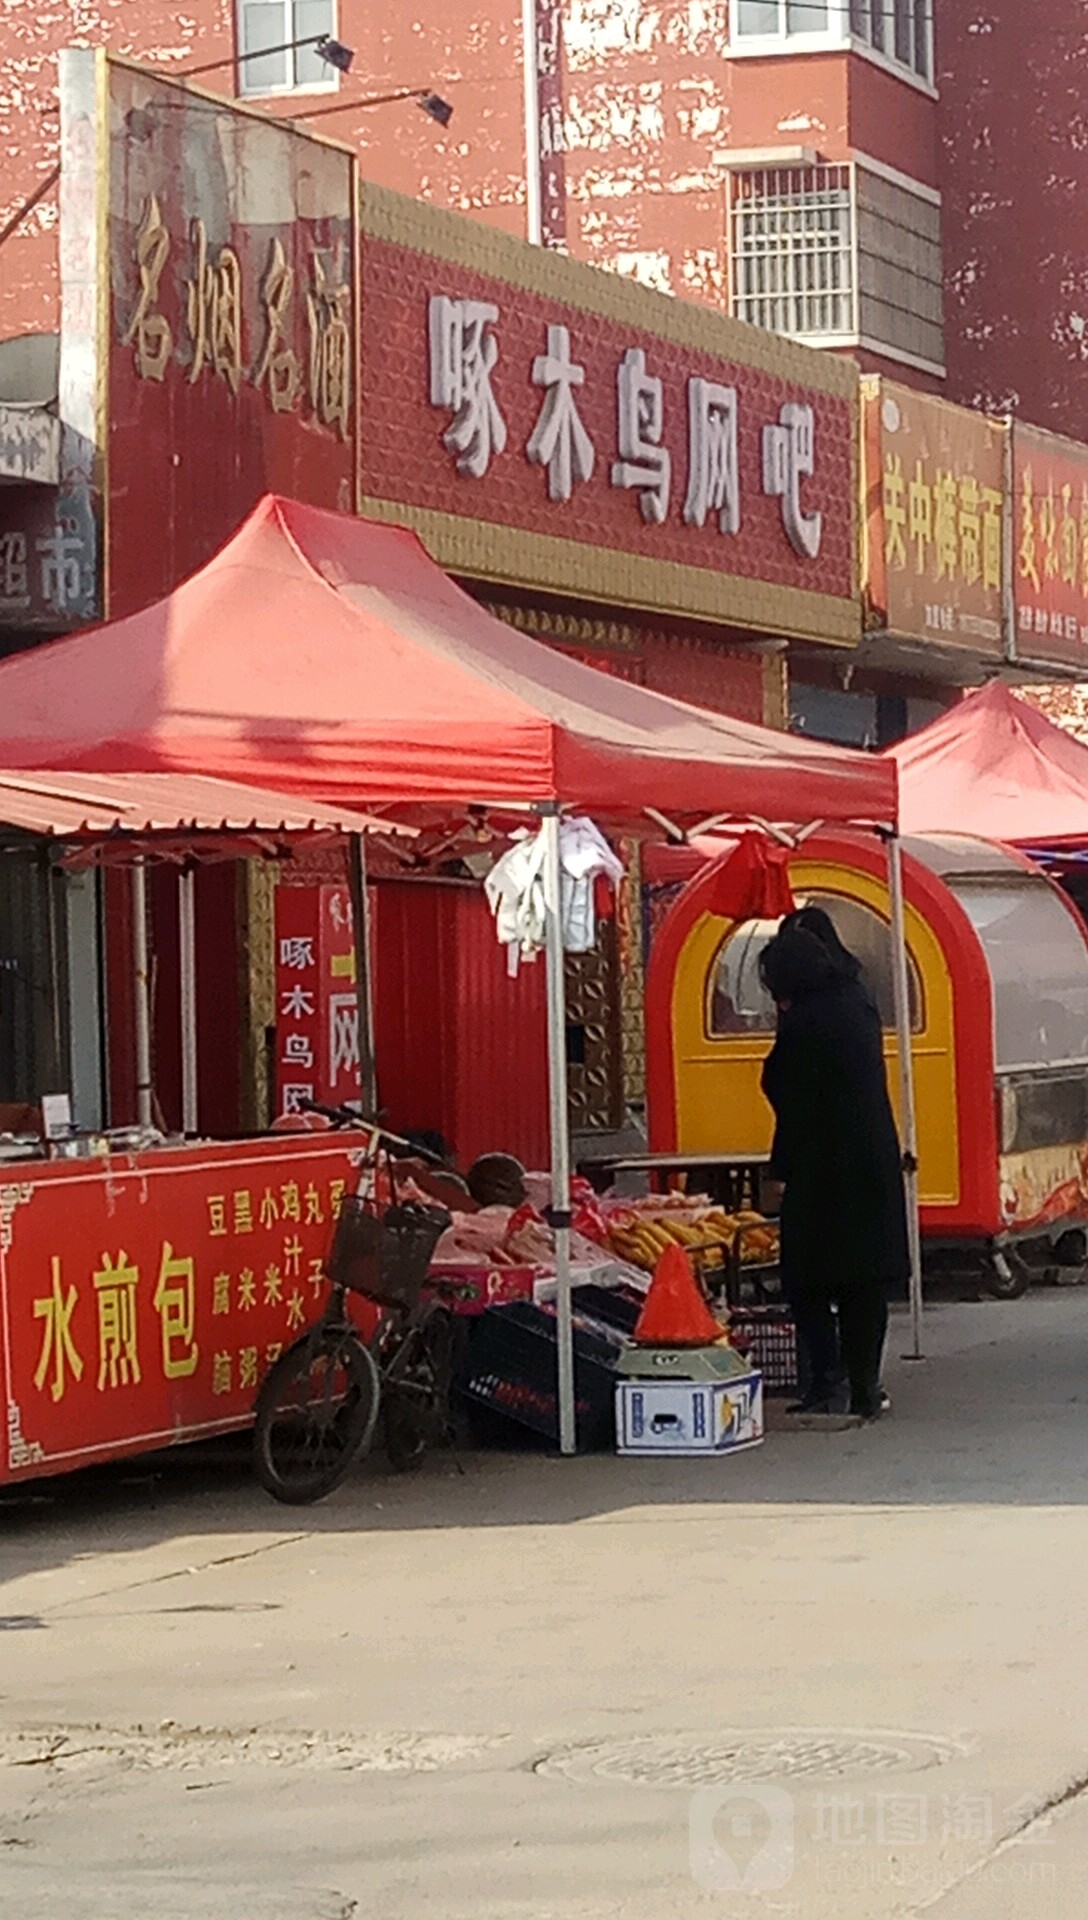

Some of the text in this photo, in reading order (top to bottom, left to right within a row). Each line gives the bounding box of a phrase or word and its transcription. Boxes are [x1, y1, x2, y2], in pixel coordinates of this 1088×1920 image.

[120, 192, 350, 442] 名烟名酒
[429, 295, 824, 559] 啄木鸟网吧
[33, 1240, 199, 1402] 水煎包
